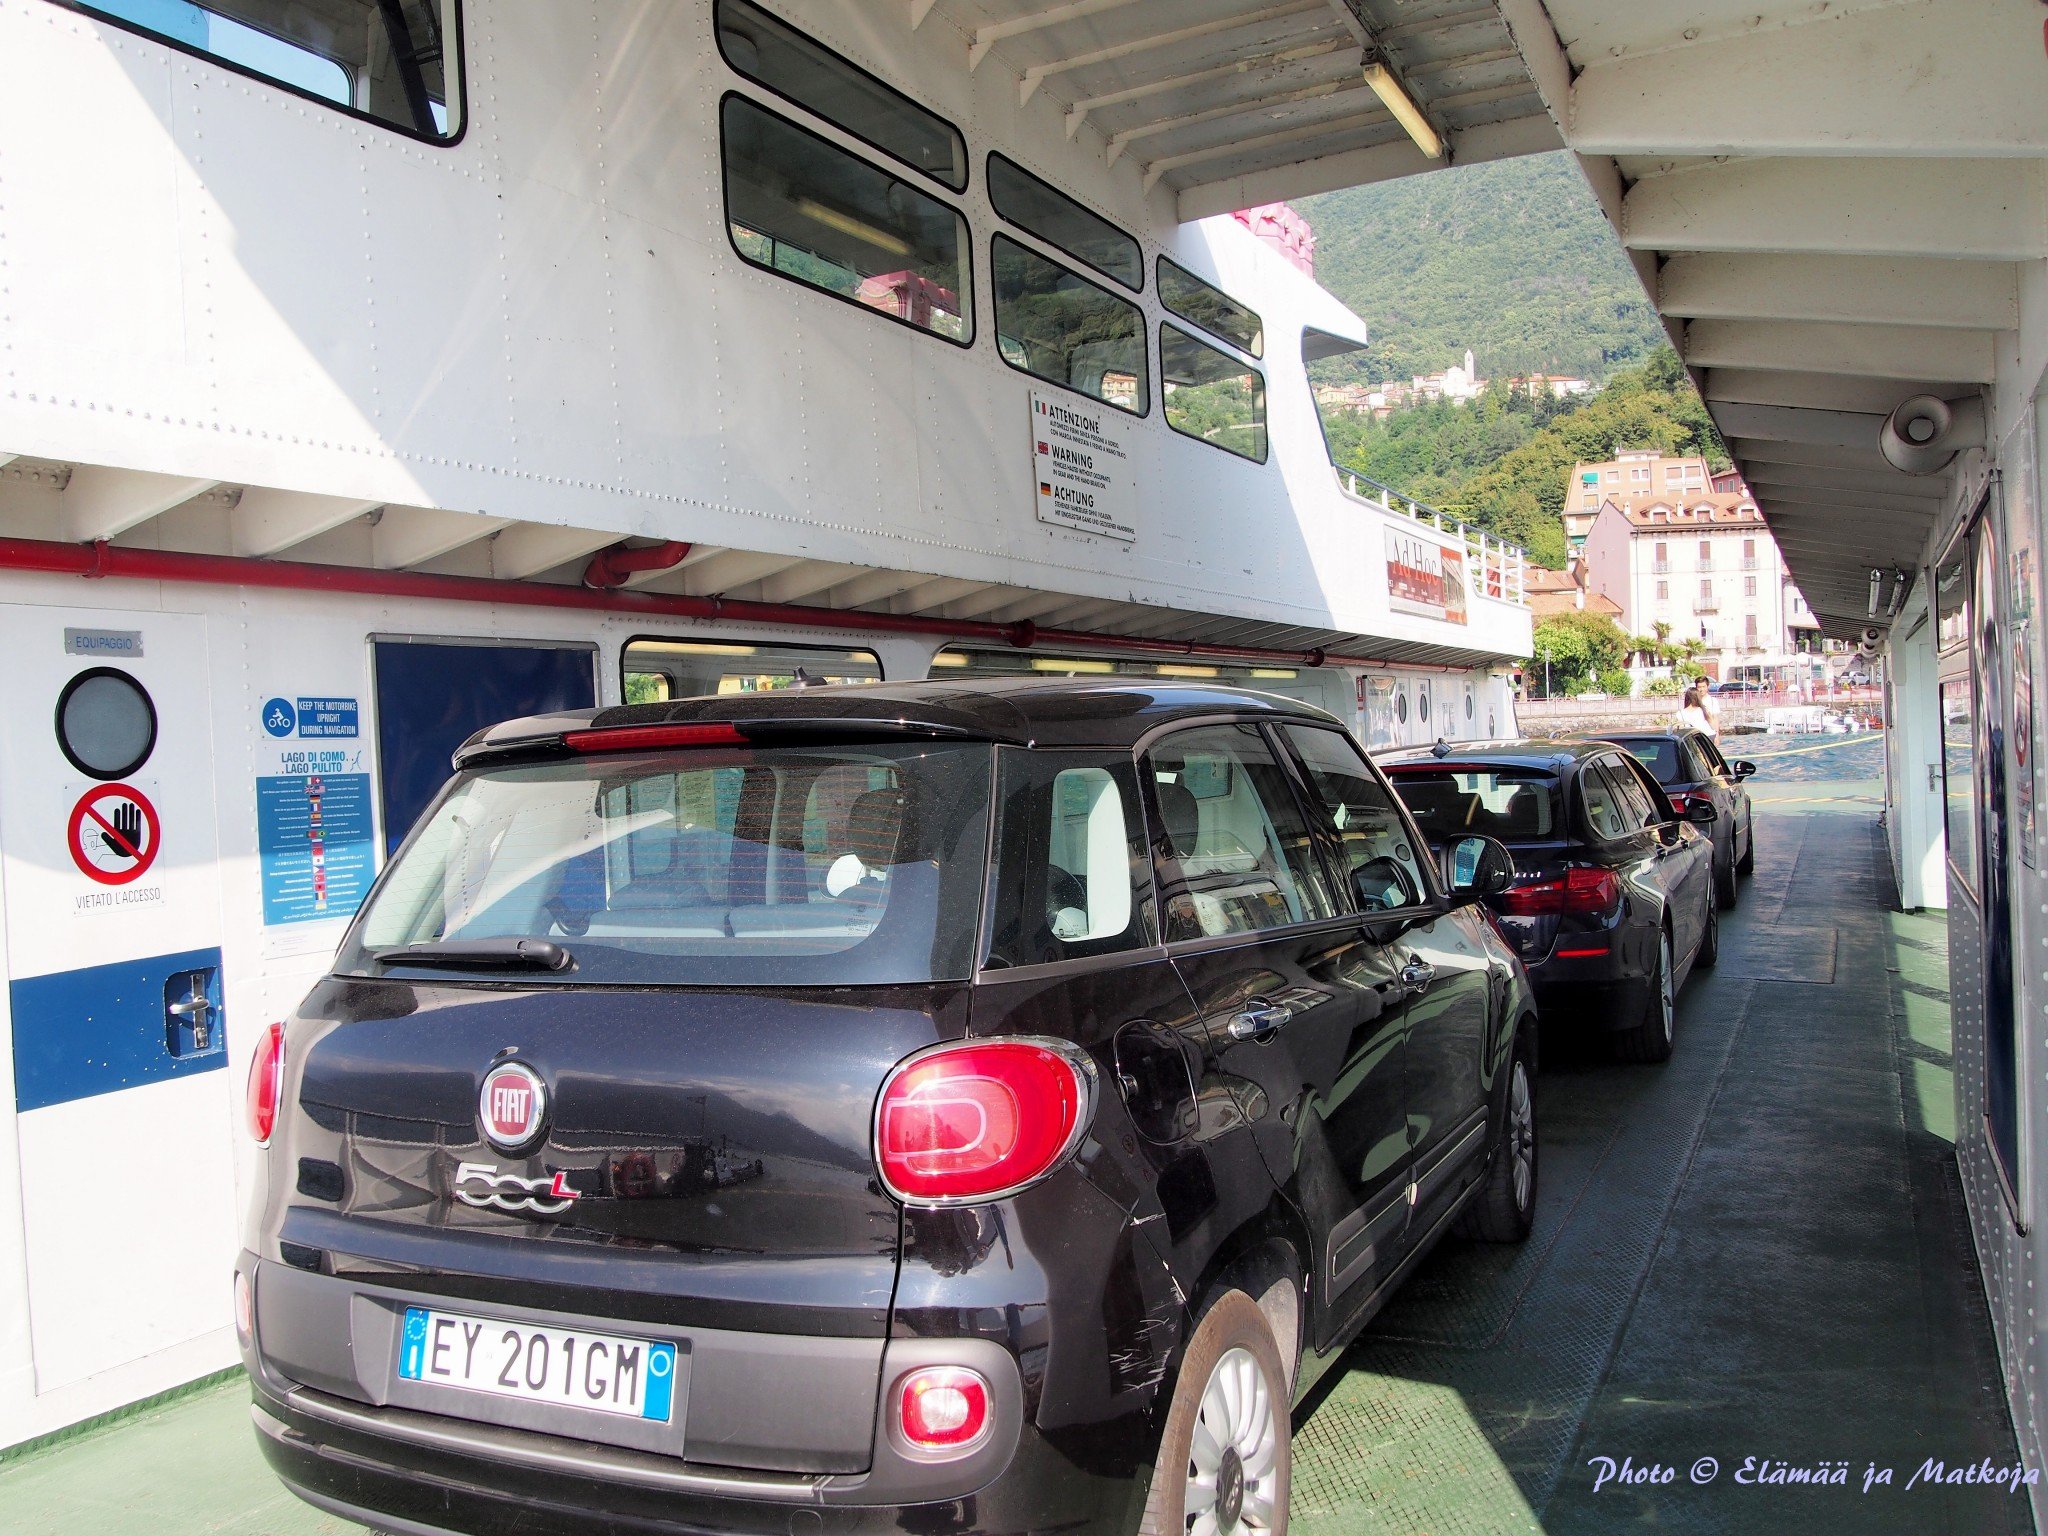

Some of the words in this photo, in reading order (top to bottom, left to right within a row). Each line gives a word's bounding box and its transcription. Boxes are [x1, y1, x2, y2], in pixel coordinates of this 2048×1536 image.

[1050, 405, 1099, 434] ATTENZIONE
[1052, 445, 1092, 469] WARNING
[1055, 486, 1094, 507] ACHTUNG
[1392, 535, 1411, 577] Ad
[1413, 542, 1438, 585] Hoc
[76, 637, 132, 649] EQUIPAGGIO
[299, 701, 313, 711] KEEP
[314, 701, 324, 711] THE
[326, 701, 356, 711] MOTORBIKE
[317, 714, 340, 722] UPRIGHT
[302, 726, 323, 734] DURING
[324, 726, 355, 734] NAVIGATION
[281, 752, 305, 763] LAGO
[308, 752, 317, 762] DI
[312, 762, 342, 773] PULITO
[75, 893, 112, 909] VIETATO
[116, 888, 160, 904] L'ACCESSO
[494, 1088, 529, 1124] FIAT
[431, 1319, 482, 1379] EY
[498, 1330, 640, 1406] 201GM
